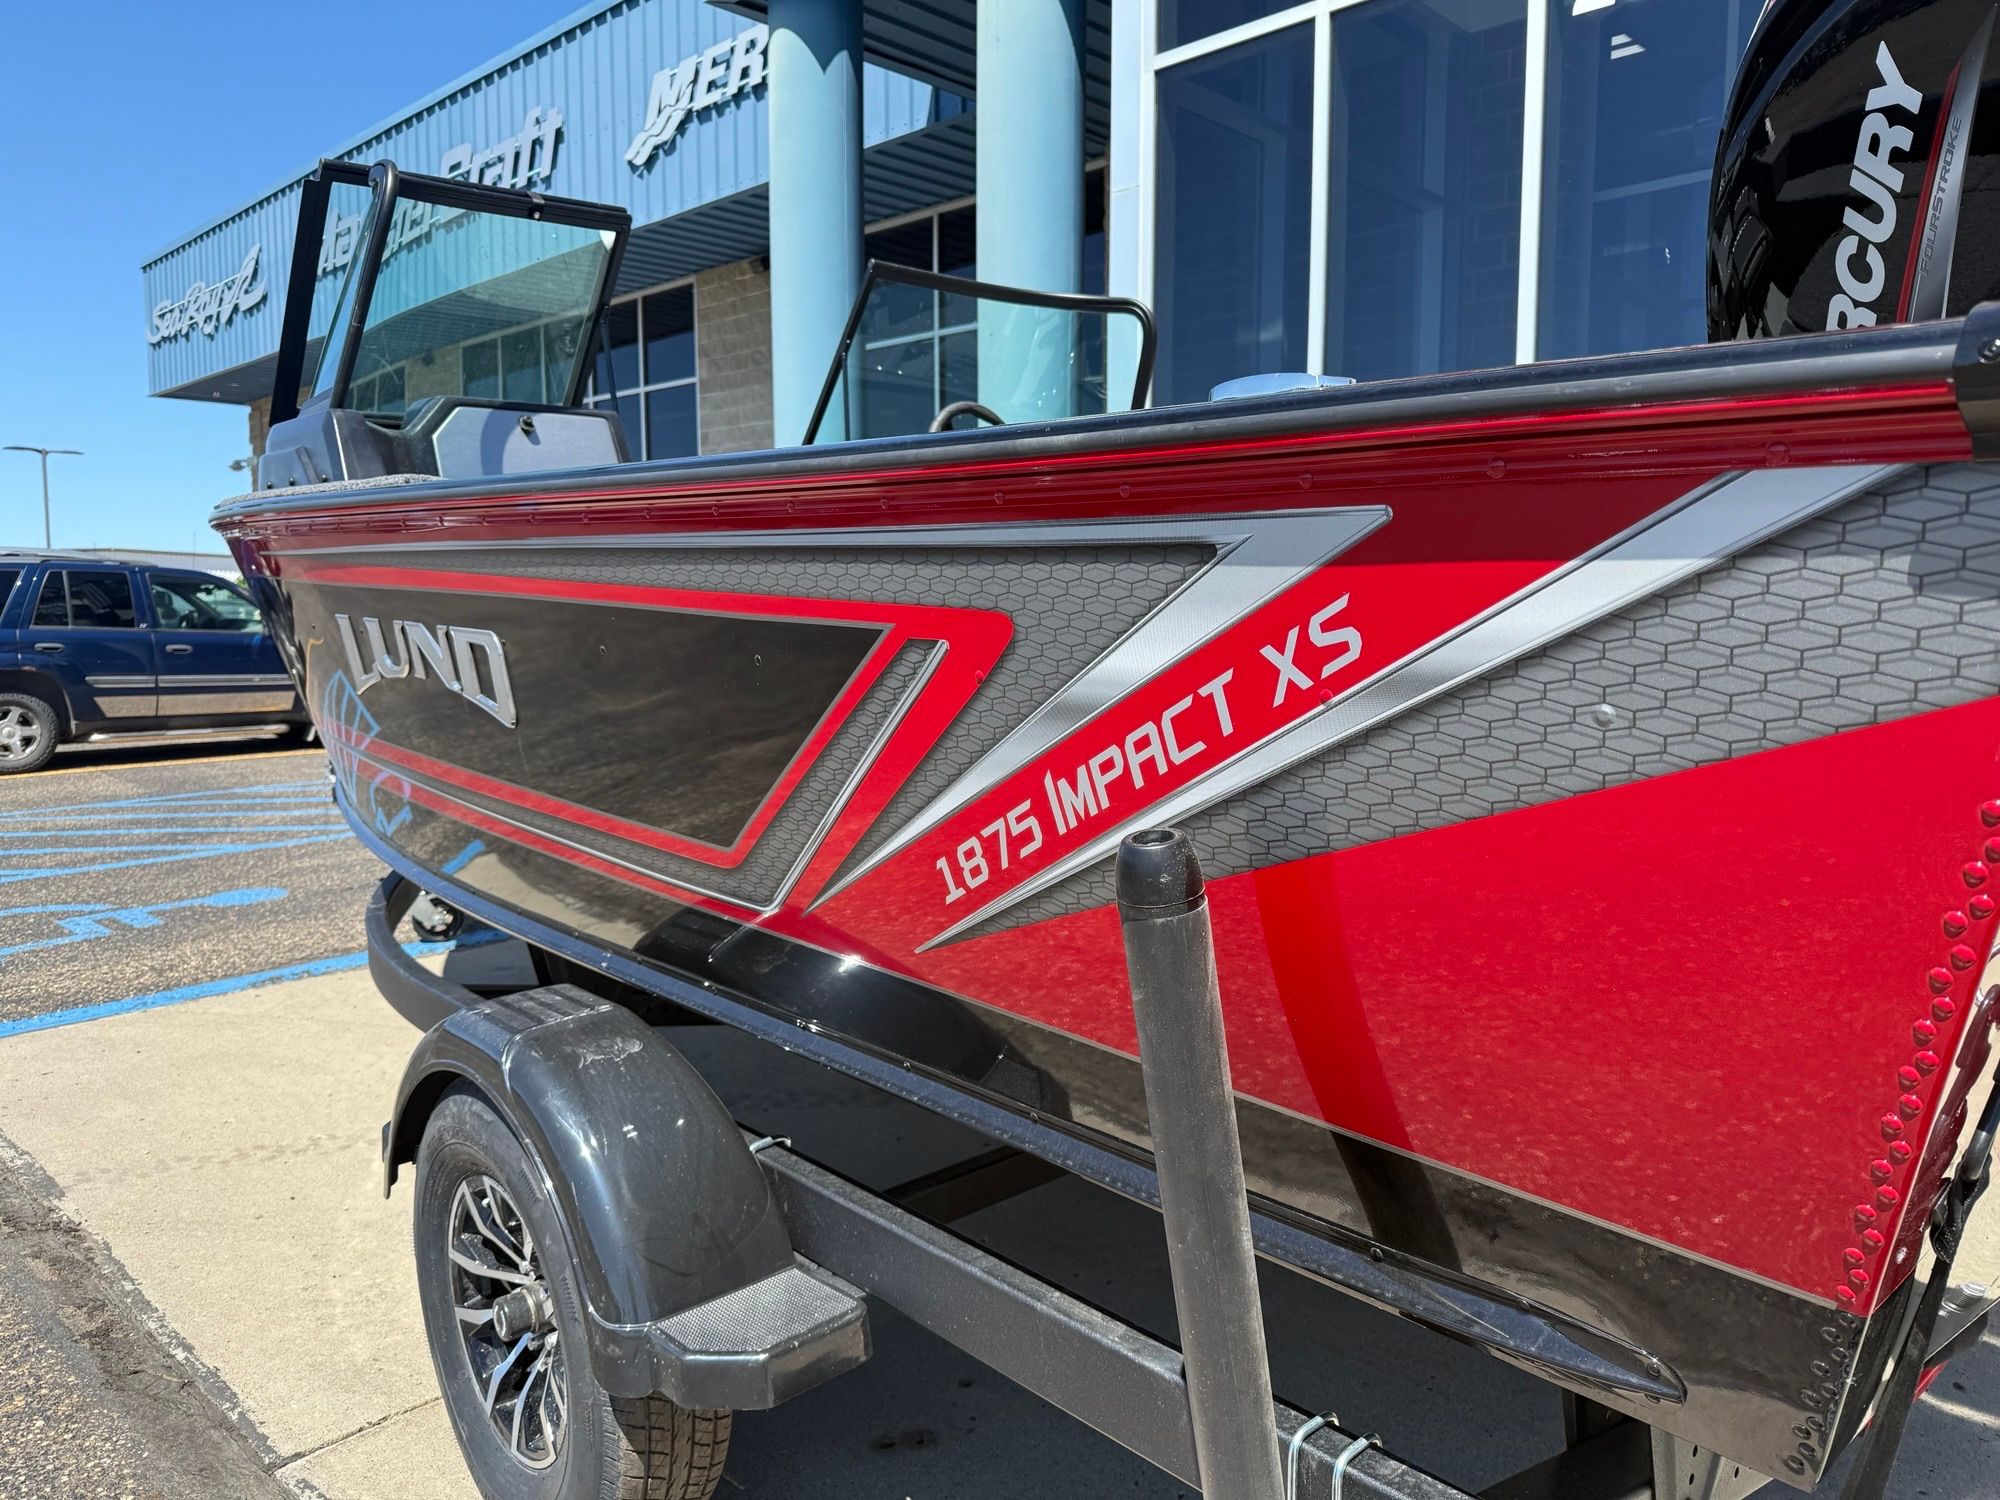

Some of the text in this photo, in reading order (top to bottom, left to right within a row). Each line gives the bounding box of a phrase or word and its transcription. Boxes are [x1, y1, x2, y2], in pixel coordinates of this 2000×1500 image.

[1919, 115, 1962, 276] FOURSTROKE
[334, 613, 517, 728] LUND
[935, 592, 1363, 905] 1875 IMPACT XS
